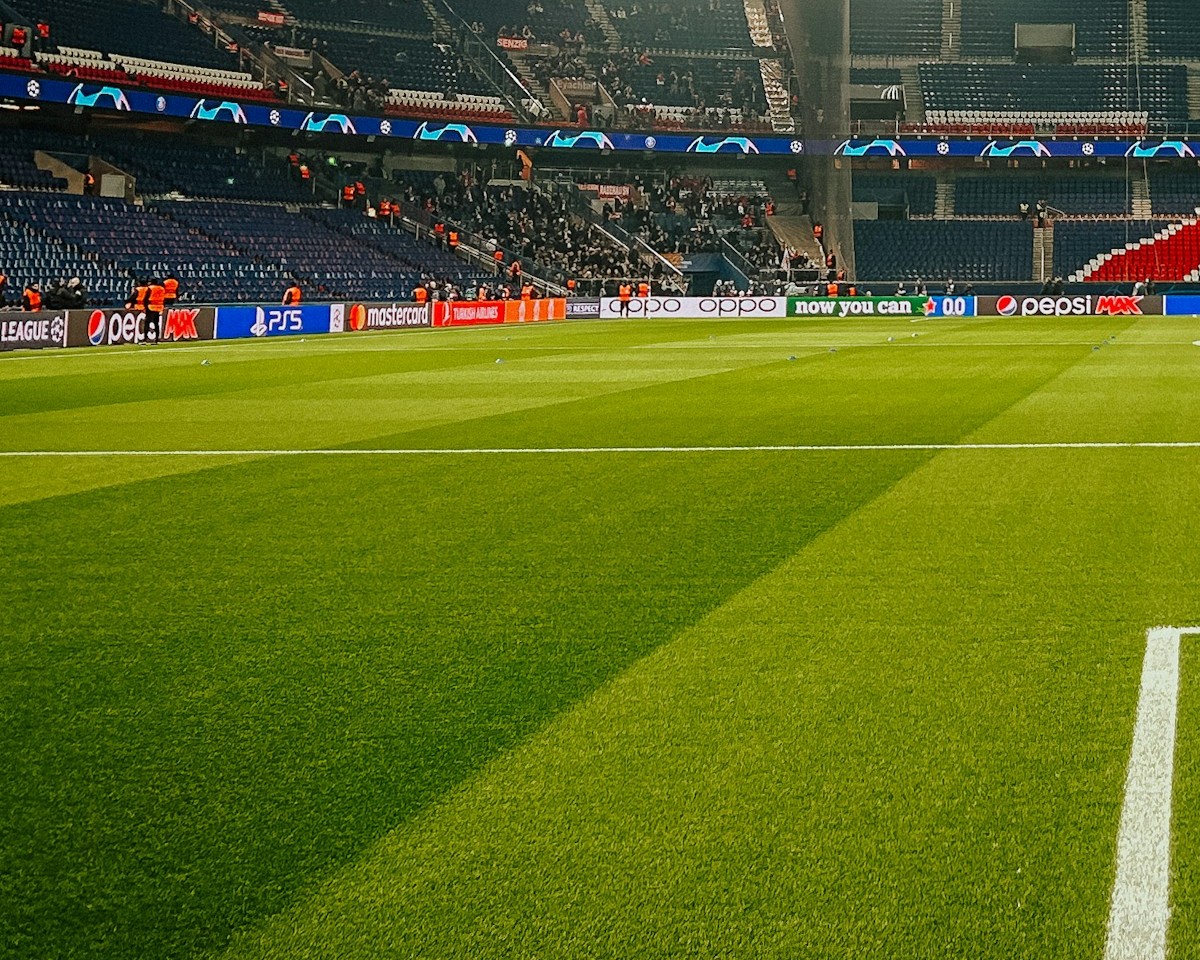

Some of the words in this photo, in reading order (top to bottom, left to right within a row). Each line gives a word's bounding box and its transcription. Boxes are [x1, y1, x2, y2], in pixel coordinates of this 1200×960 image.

[367, 302, 429, 327] mastercard
[453, 308, 476, 320] TURKISH
[476, 306, 498, 319] AIRLINES
[573, 305, 599, 313] RESPECT
[699, 298, 776, 317] oppo
[795, 300, 835, 314] now
[838, 300, 874, 317] you
[877, 299, 912, 314] can
[1021, 295, 1092, 317] pepsi
[1095, 295, 1144, 315] MAX
[163, 308, 201, 341] MAX
[269, 309, 302, 331] PS5
[2, 321, 49, 341] LEAGUE
